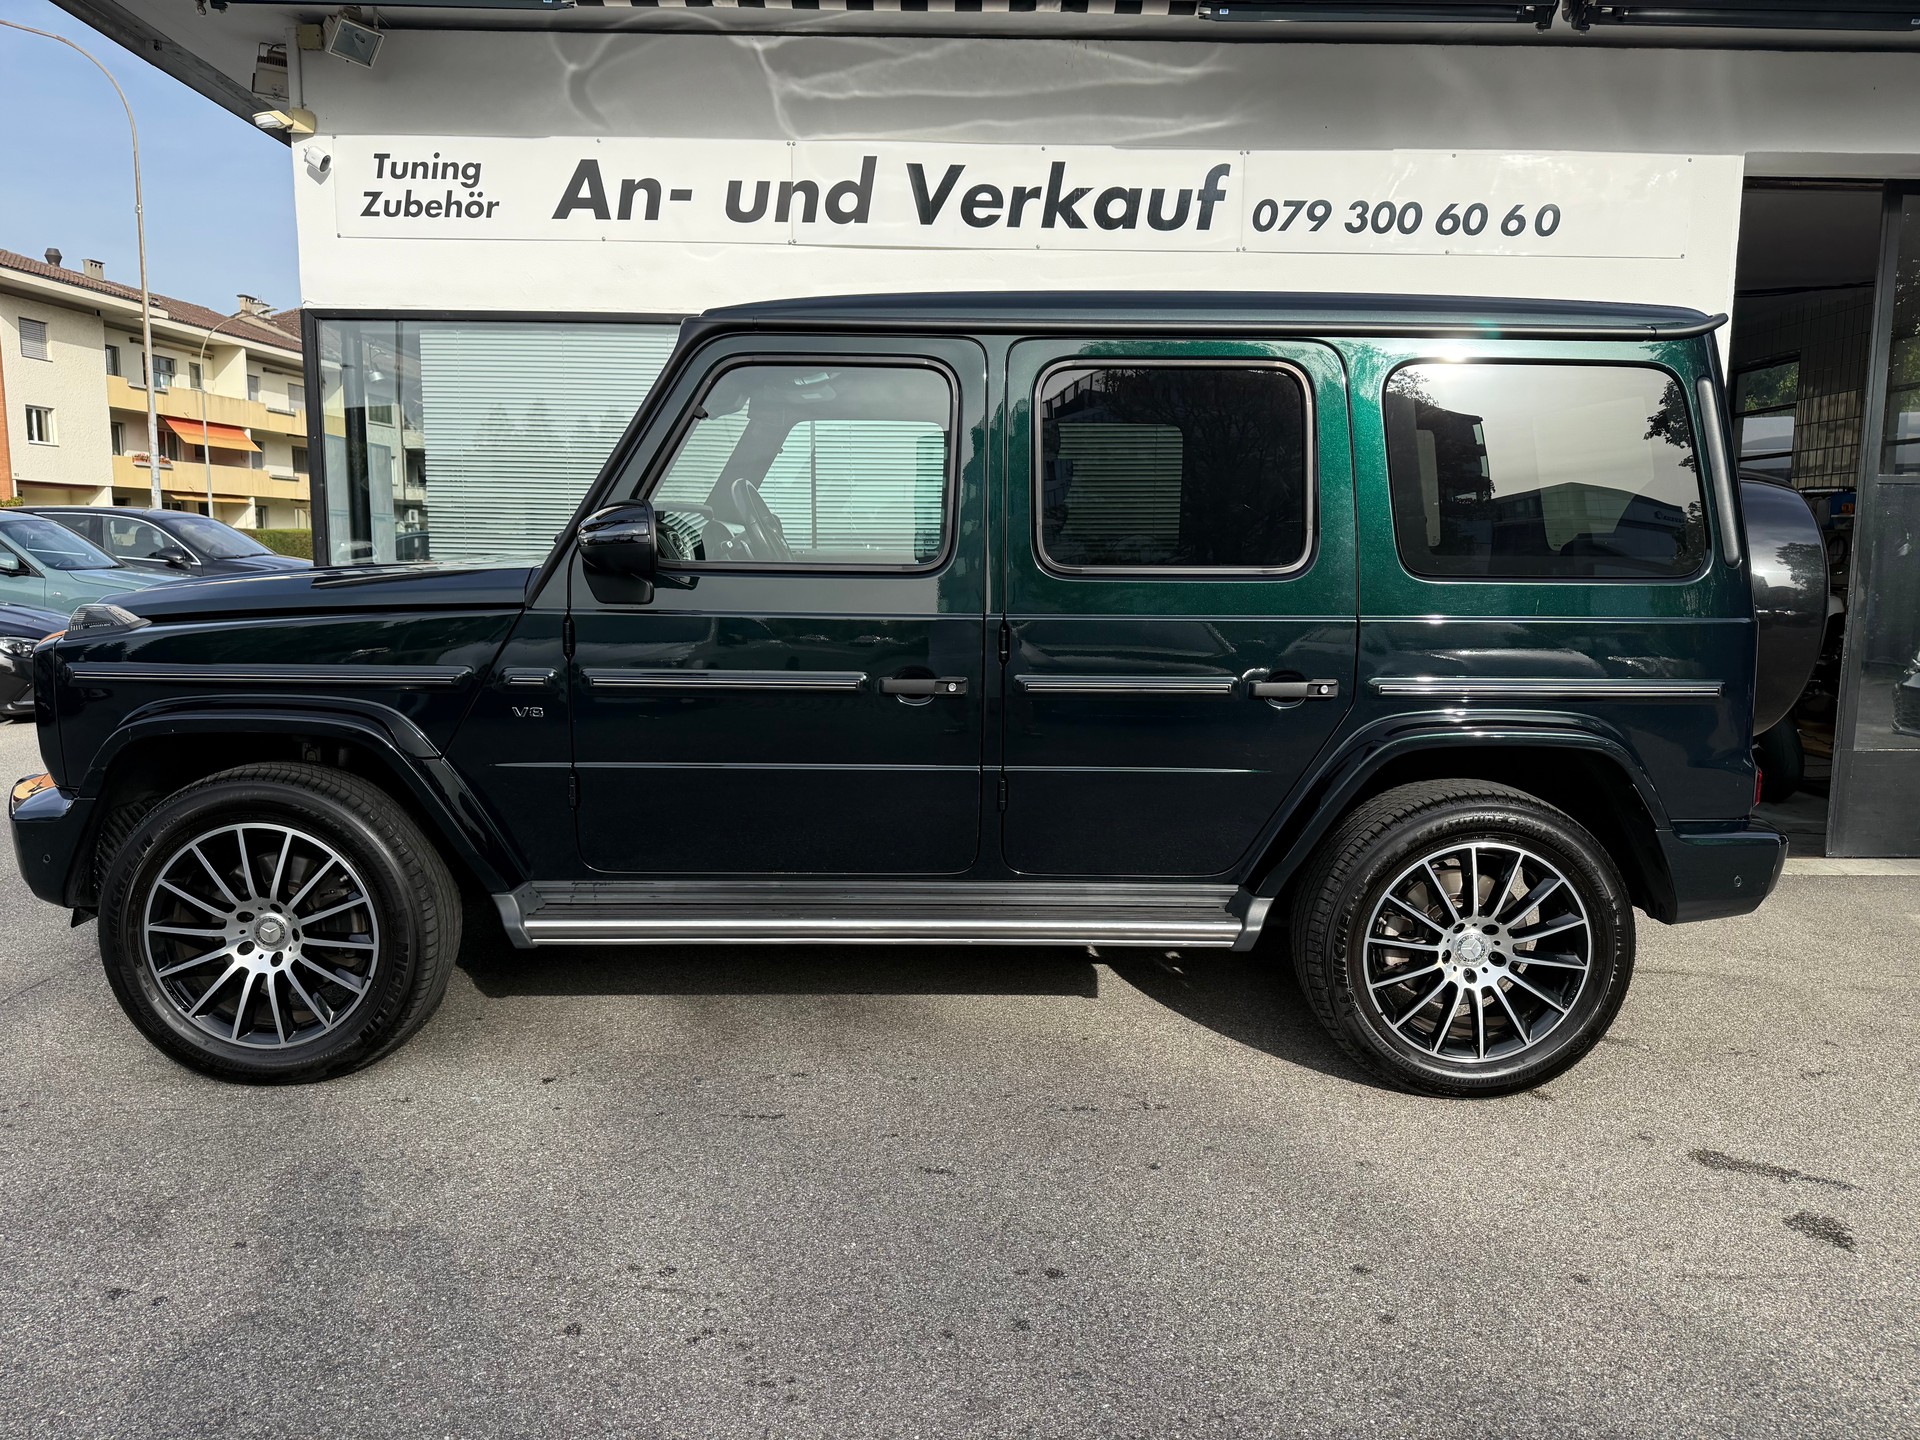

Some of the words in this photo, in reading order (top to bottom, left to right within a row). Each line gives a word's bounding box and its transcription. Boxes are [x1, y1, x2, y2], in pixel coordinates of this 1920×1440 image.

[373, 153, 482, 187] Tuning
[359, 189, 500, 219] Zubehör
[551, 158, 693, 221] An-
[725, 155, 878, 225] und
[906, 161, 1231, 232] Verkauf
[1252, 198, 1331, 233] 079
[1344, 200, 1423, 235] 300
[1435, 202, 1489, 236] 60
[1500, 203, 1561, 237] 60
[512, 706, 544, 718] V8
[357, 941, 409, 1042] MICHELIN
